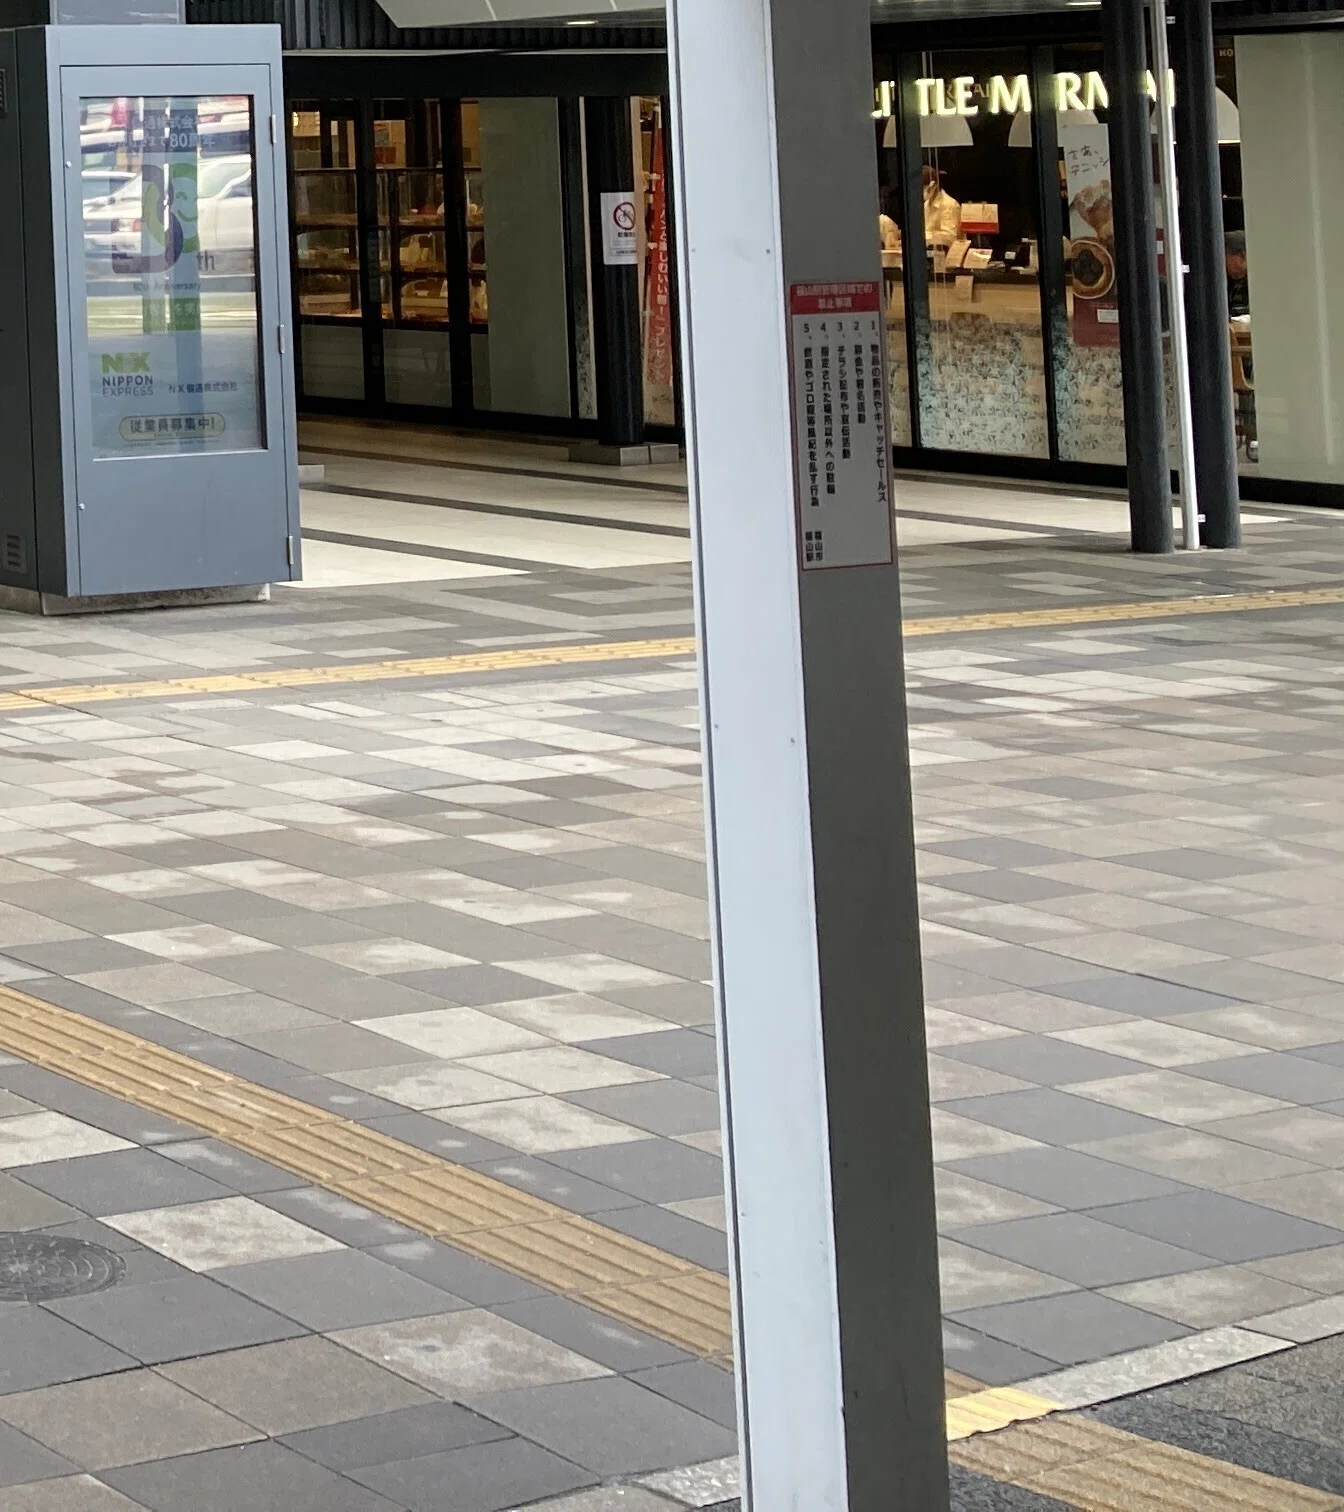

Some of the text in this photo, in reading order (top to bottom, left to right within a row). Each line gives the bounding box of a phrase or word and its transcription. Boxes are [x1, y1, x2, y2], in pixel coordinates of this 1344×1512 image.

[101, 352, 150, 374] NX
[102, 375, 153, 387] NIPPON
[102, 387, 153, 397] EXPRESS
